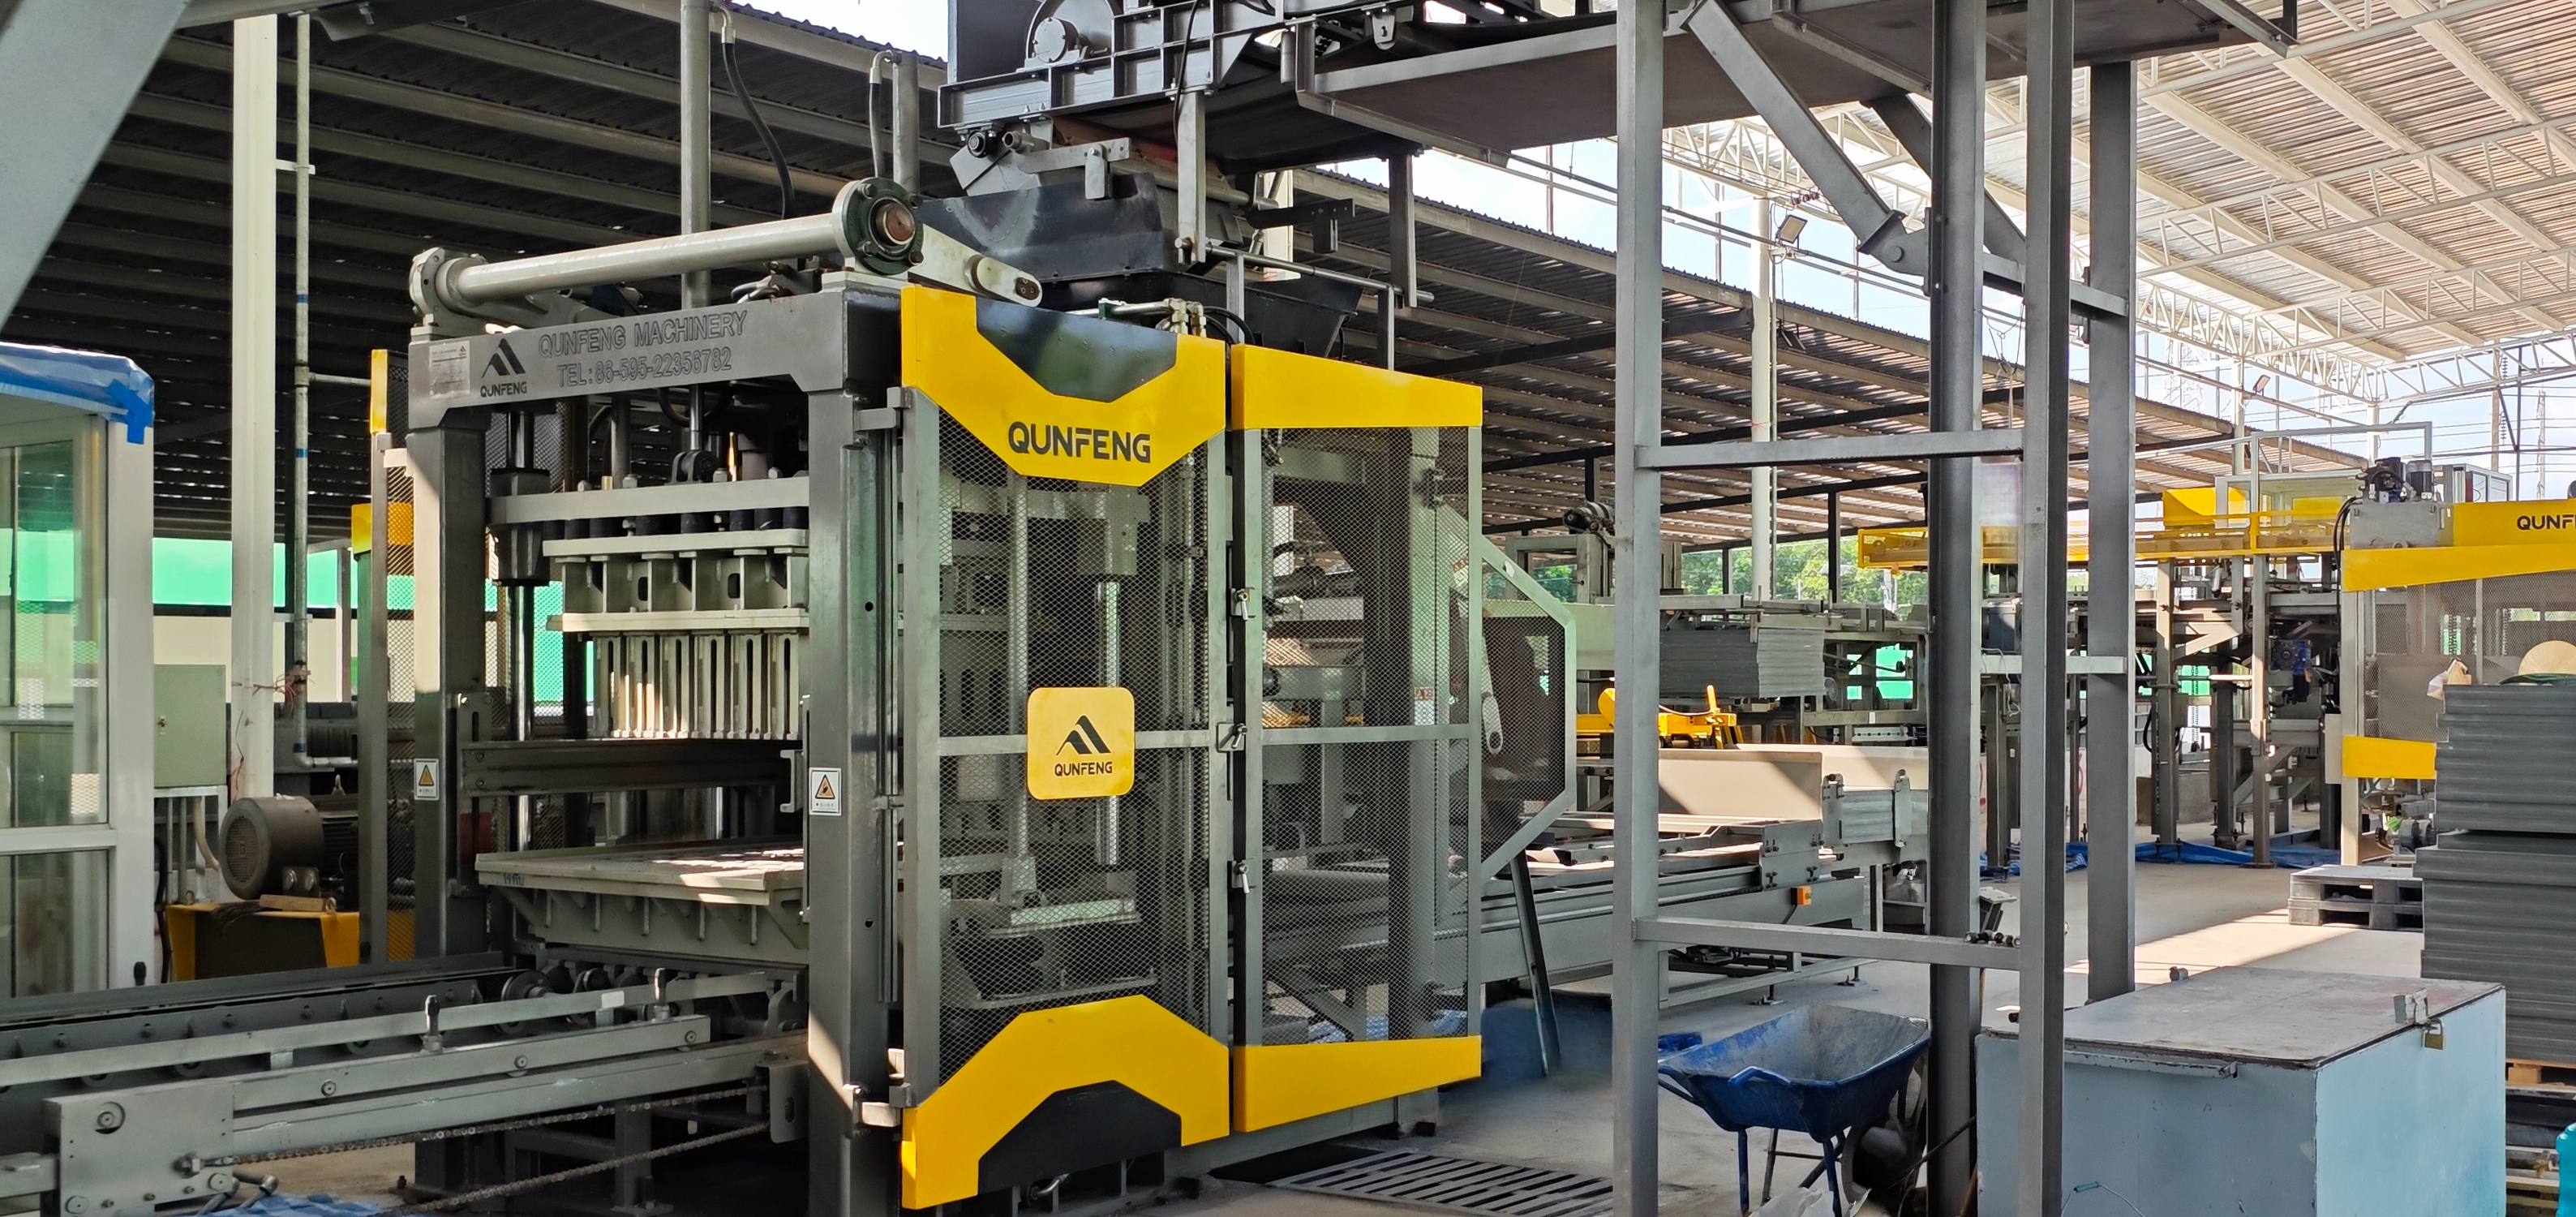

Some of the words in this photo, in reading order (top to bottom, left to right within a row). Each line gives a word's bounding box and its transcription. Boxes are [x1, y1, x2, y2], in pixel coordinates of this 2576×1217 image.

[539, 325, 625, 358] QUNFENG
[634, 310, 747, 347] MACHINERY
[480, 381, 527, 398] QUNFENG
[1008, 421, 1151, 463] QUNFENG
[2517, 514, 2576, 531] QUNF
[1054, 761, 1113, 776] QUNFENG
